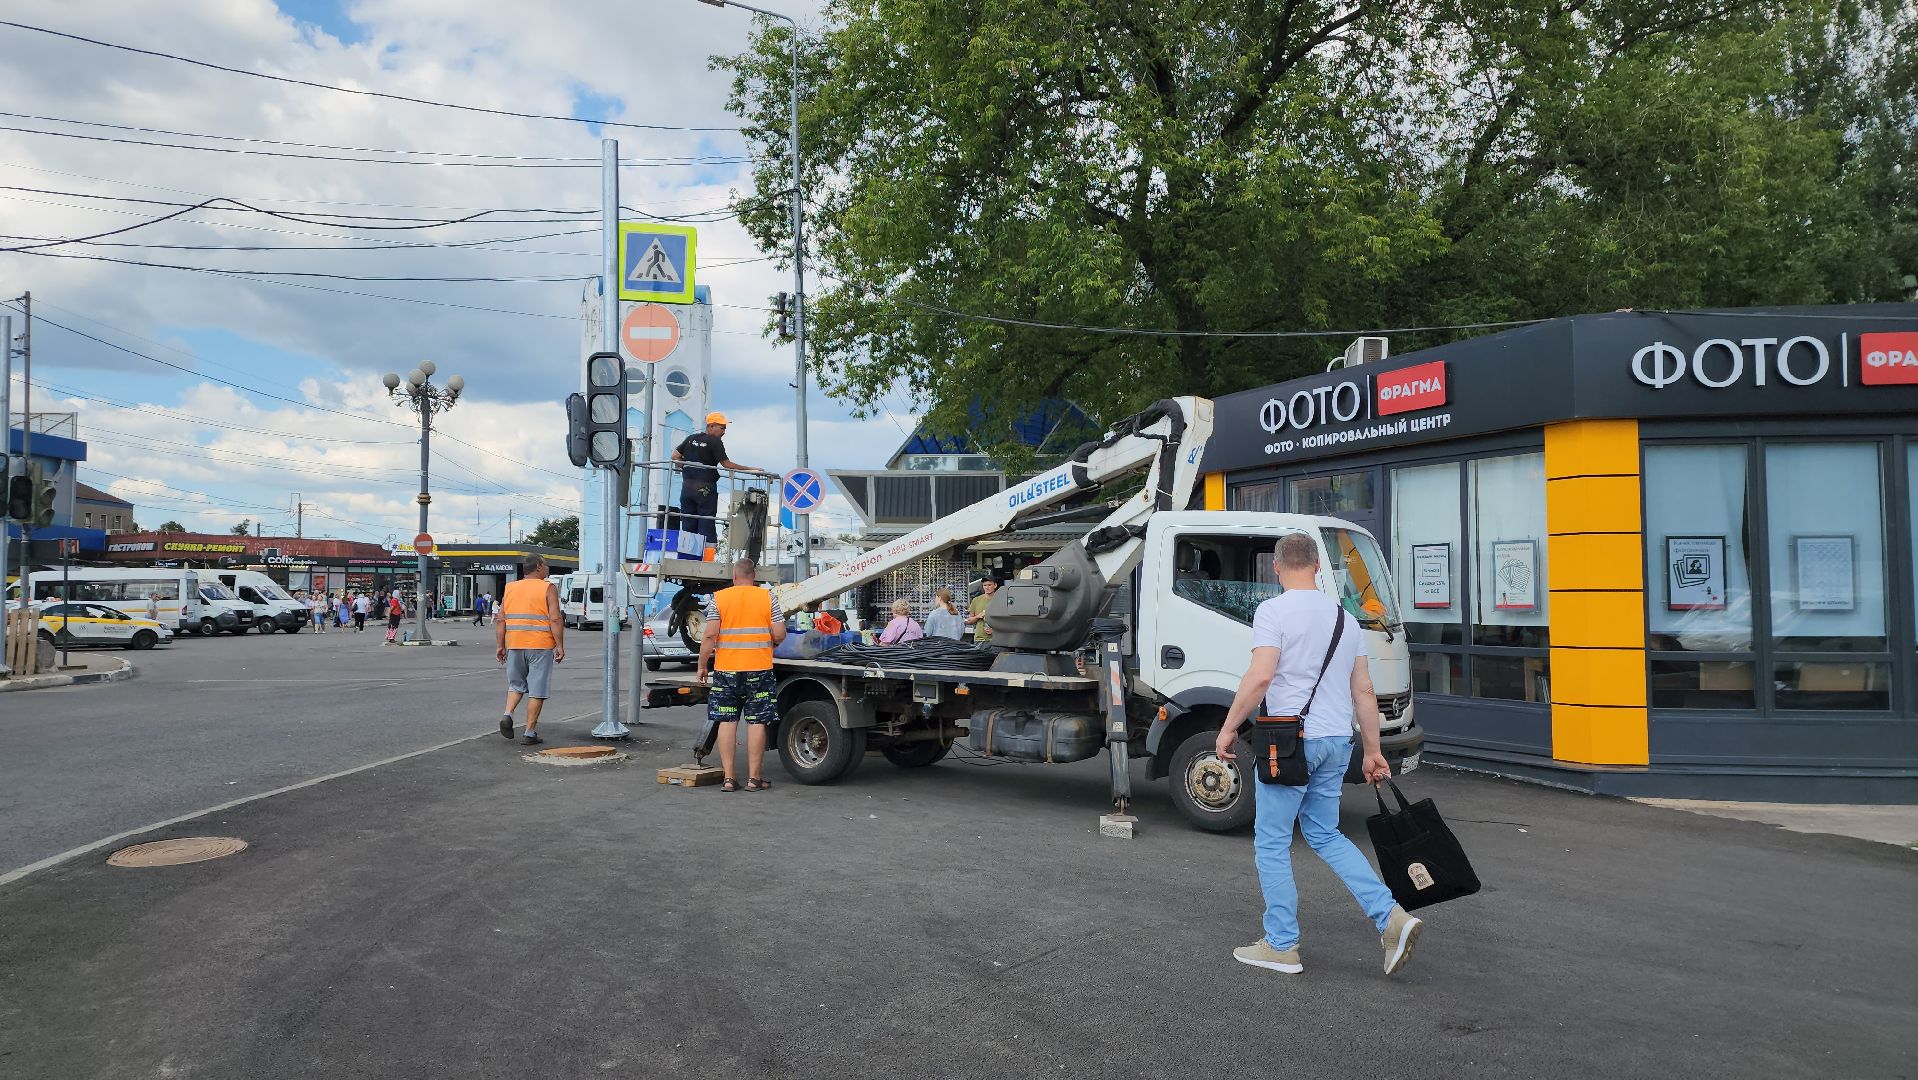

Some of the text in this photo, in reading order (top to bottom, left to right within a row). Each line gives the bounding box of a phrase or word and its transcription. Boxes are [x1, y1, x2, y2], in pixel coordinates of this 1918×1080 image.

[1632, 336, 1918, 388] ФОТО ФРА
[1259, 376, 1442, 435] ФОТО ФРАГМА
[1264, 413, 1451, 454] ФОТО КОПИРОВАЛЬНЫЙ ЦЕНТР
